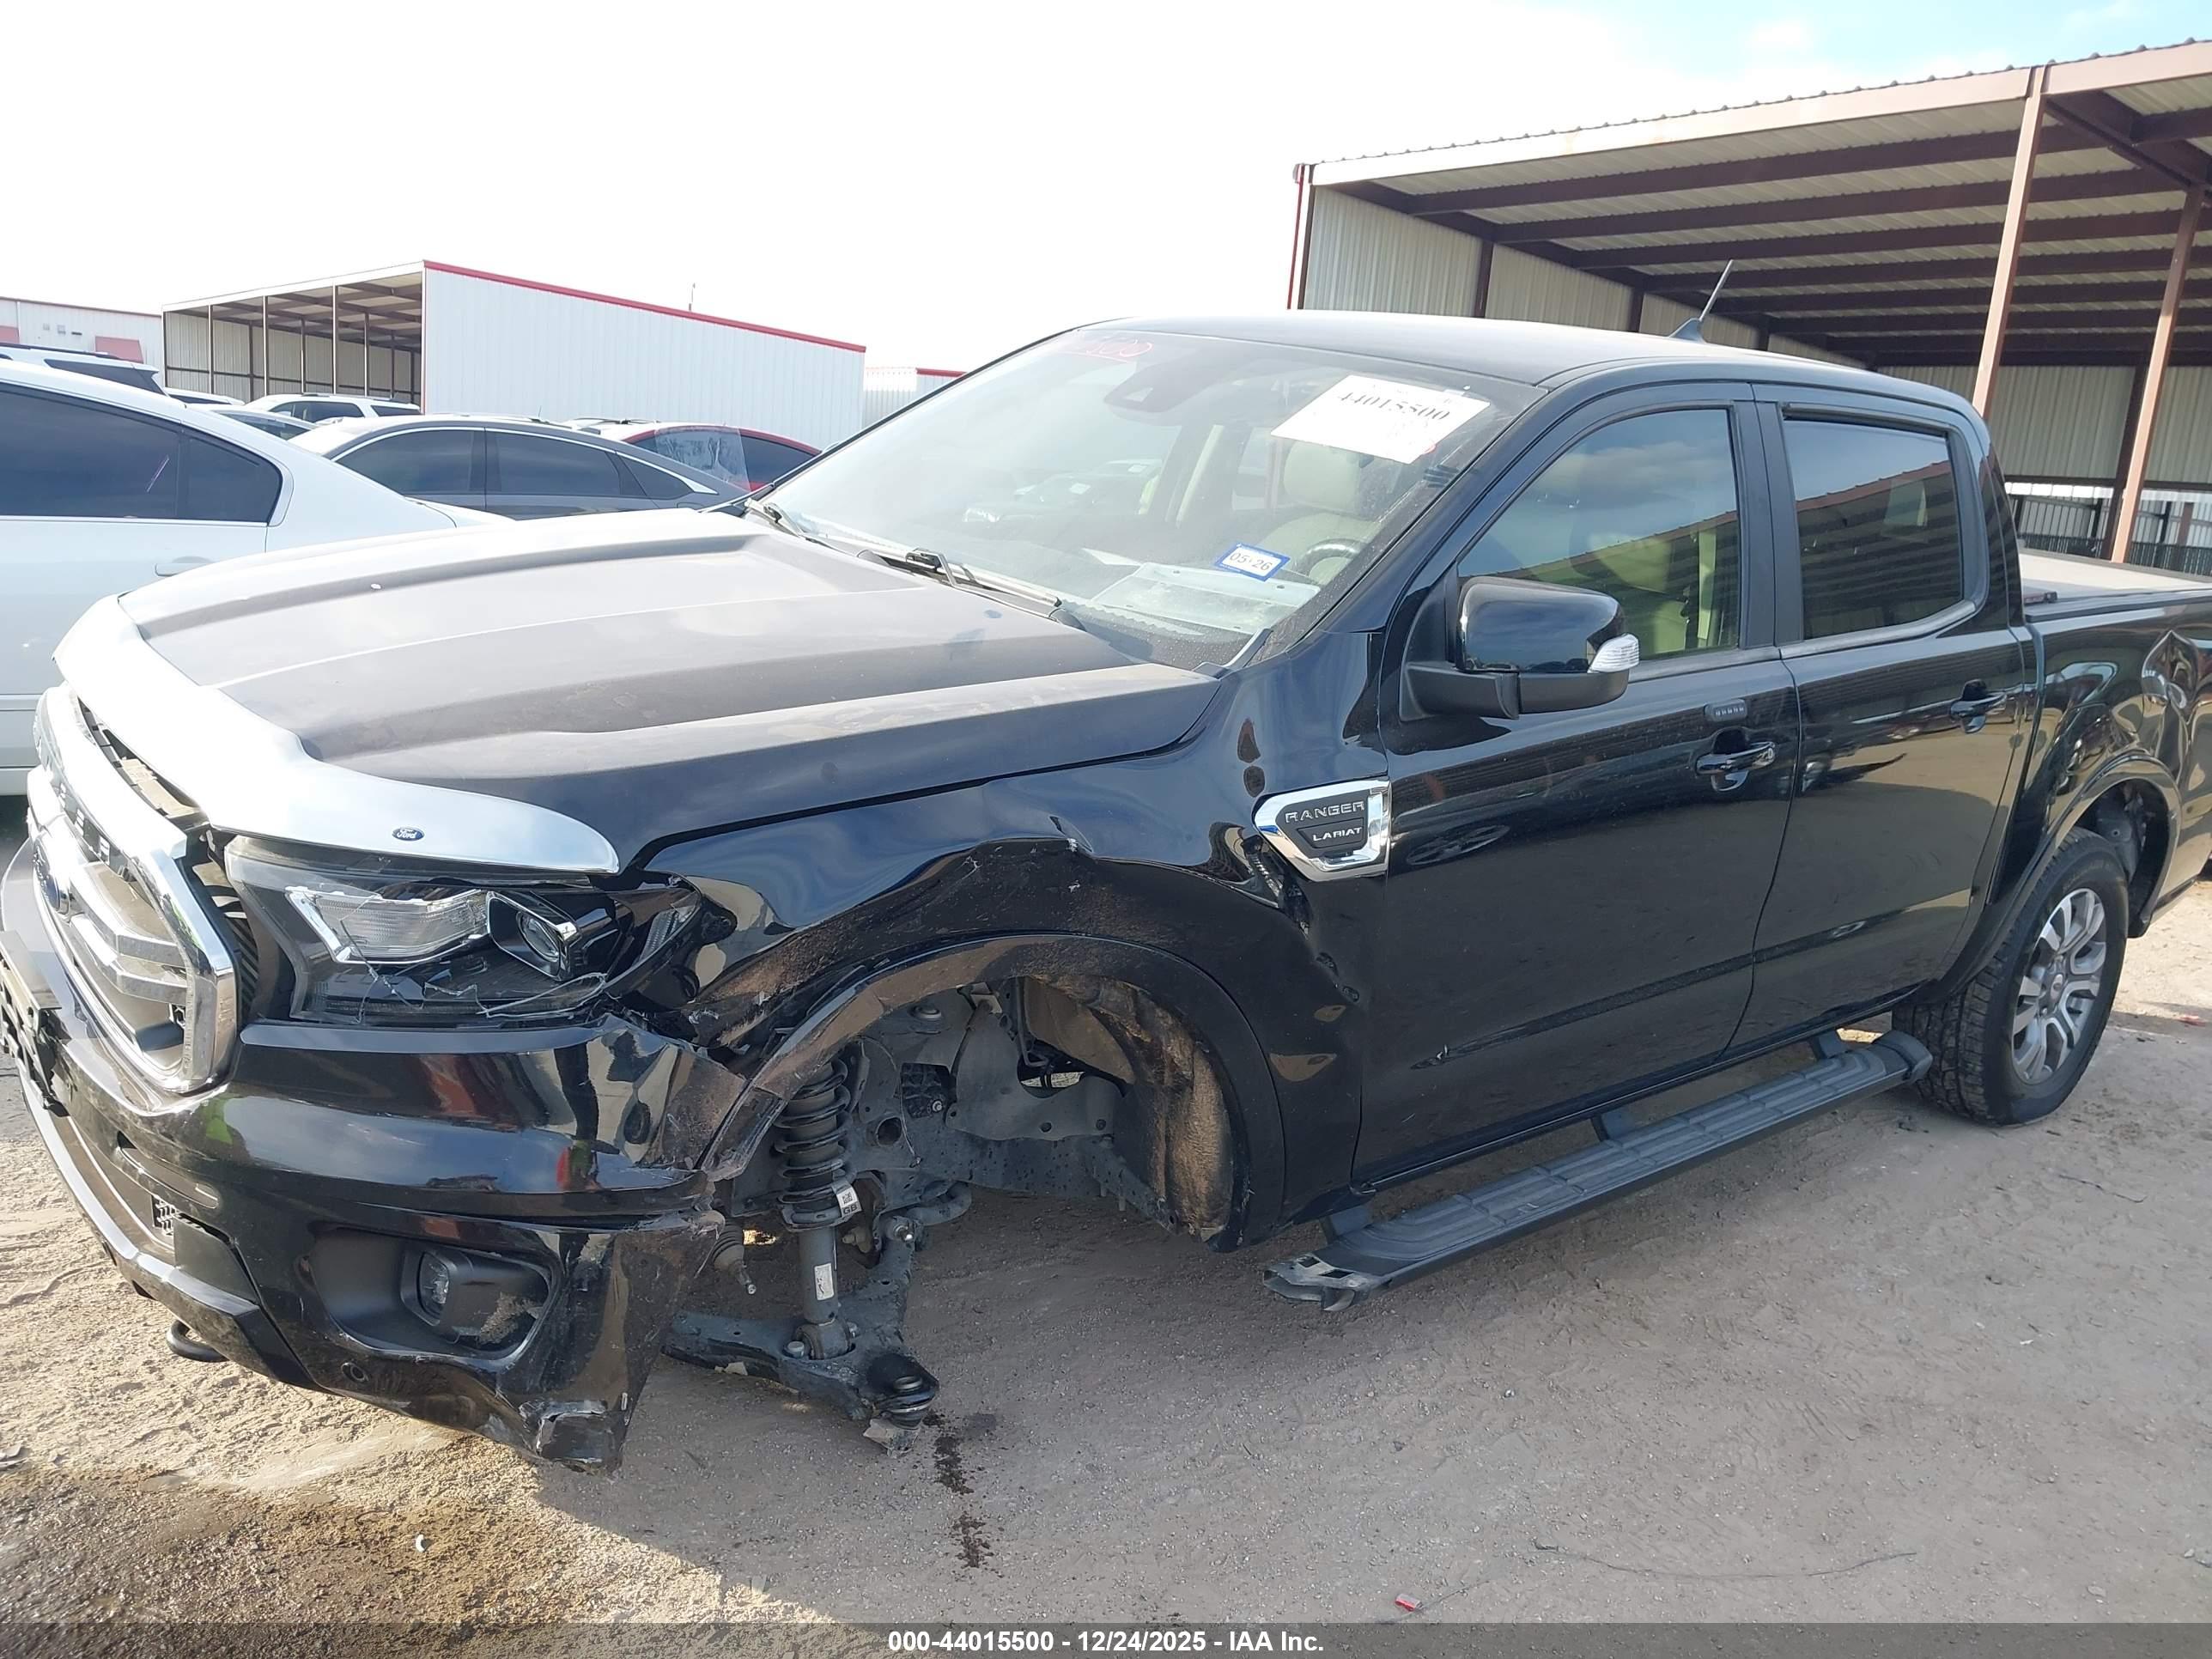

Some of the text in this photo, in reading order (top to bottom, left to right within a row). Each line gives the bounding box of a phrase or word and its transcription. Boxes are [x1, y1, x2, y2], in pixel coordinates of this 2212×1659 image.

[1337, 392, 1450, 420] 44015500
[1285, 801, 1365, 823] RANGER
[397, 829, 417, 839] Ford
[1312, 827, 1363, 842] LARIAT
[842, 1204, 858, 1215] GB
